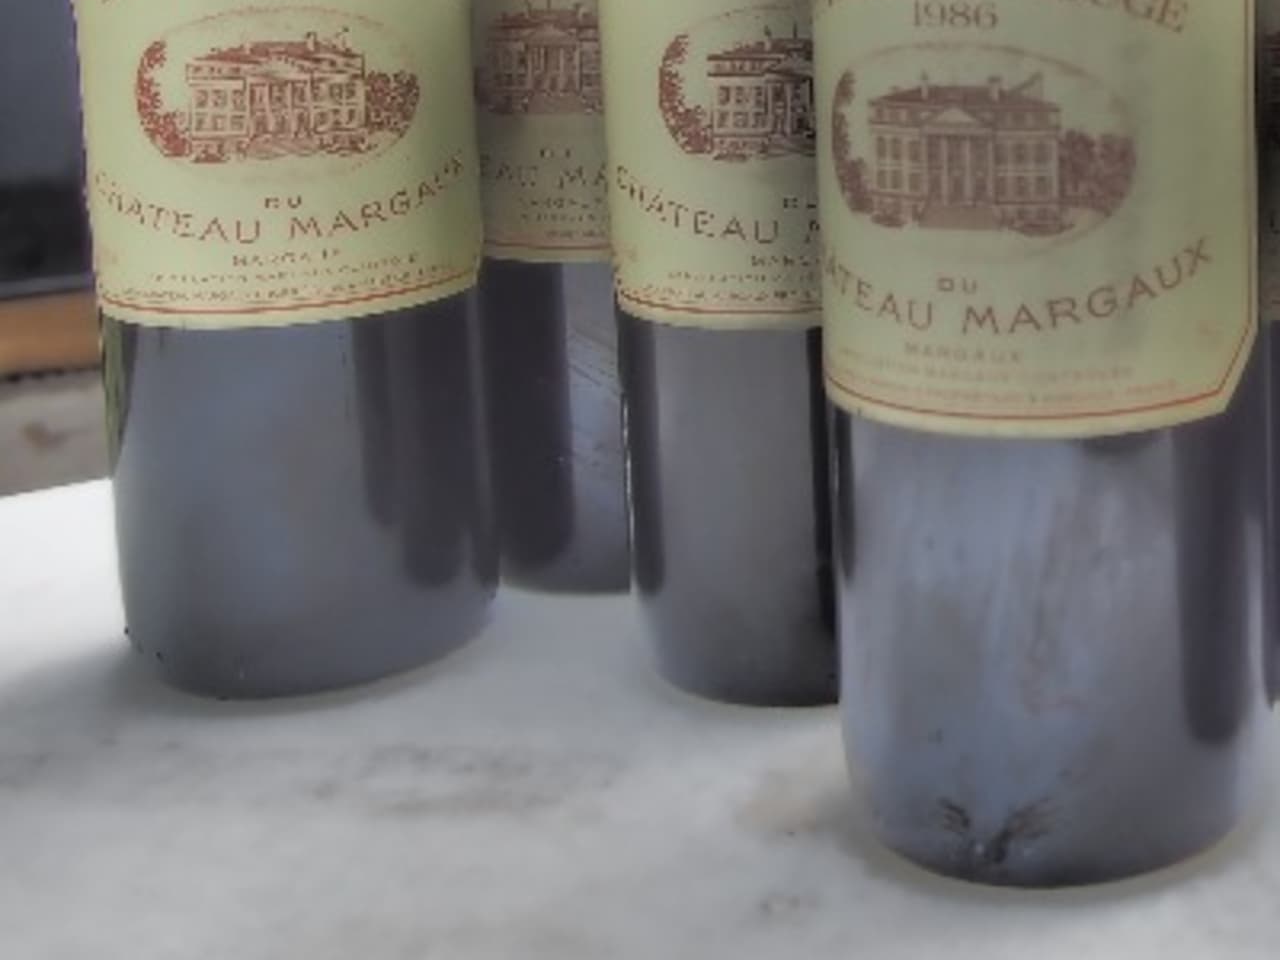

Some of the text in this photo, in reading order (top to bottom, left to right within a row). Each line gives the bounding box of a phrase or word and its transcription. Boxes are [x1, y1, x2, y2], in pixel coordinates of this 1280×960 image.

[911, 0, 1000, 30] 1986
[288, 150, 465, 240] MARGAUX
[937, 276, 979, 293] DU
[960, 236, 1213, 336] MARGAUX
